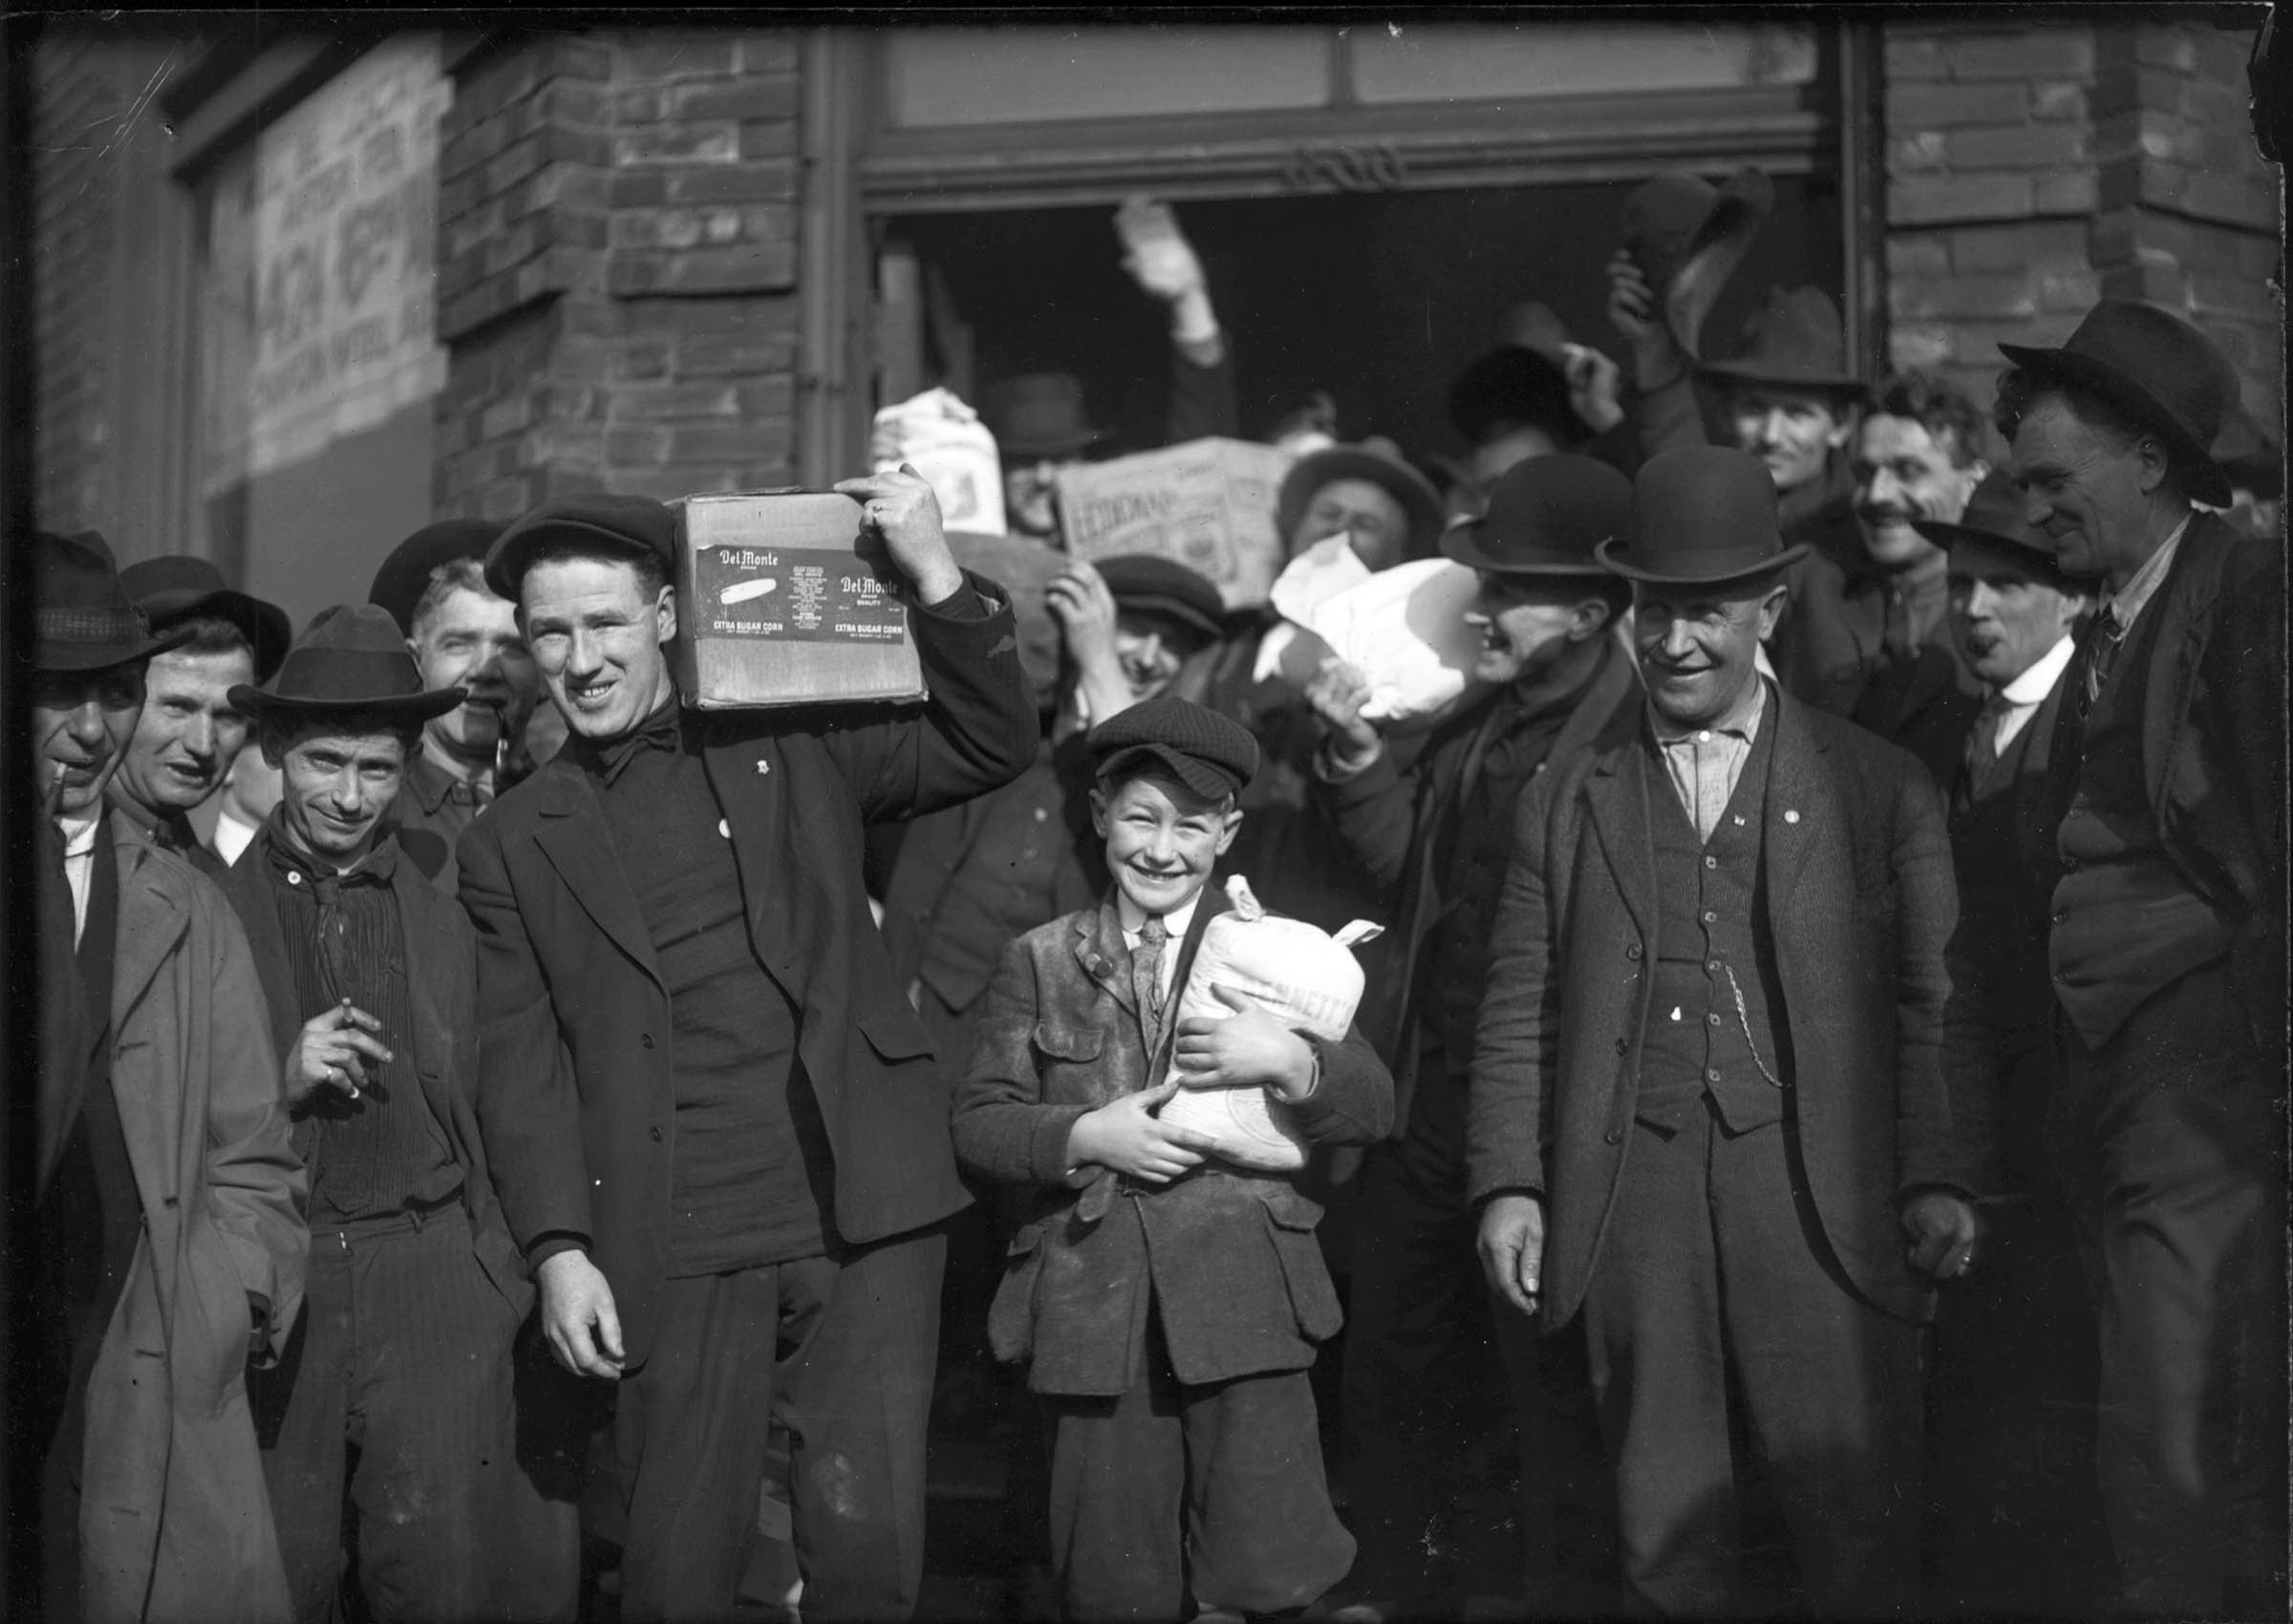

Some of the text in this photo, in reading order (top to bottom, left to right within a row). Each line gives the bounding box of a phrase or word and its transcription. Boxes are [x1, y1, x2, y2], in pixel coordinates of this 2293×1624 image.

[719, 549, 779, 566] Del Monte
[841, 576, 861, 593] Del
[713, 620, 783, 631] EXTRA SUGAR CORN
[835, 623, 903, 635] EXTRA SUGAR CORN
